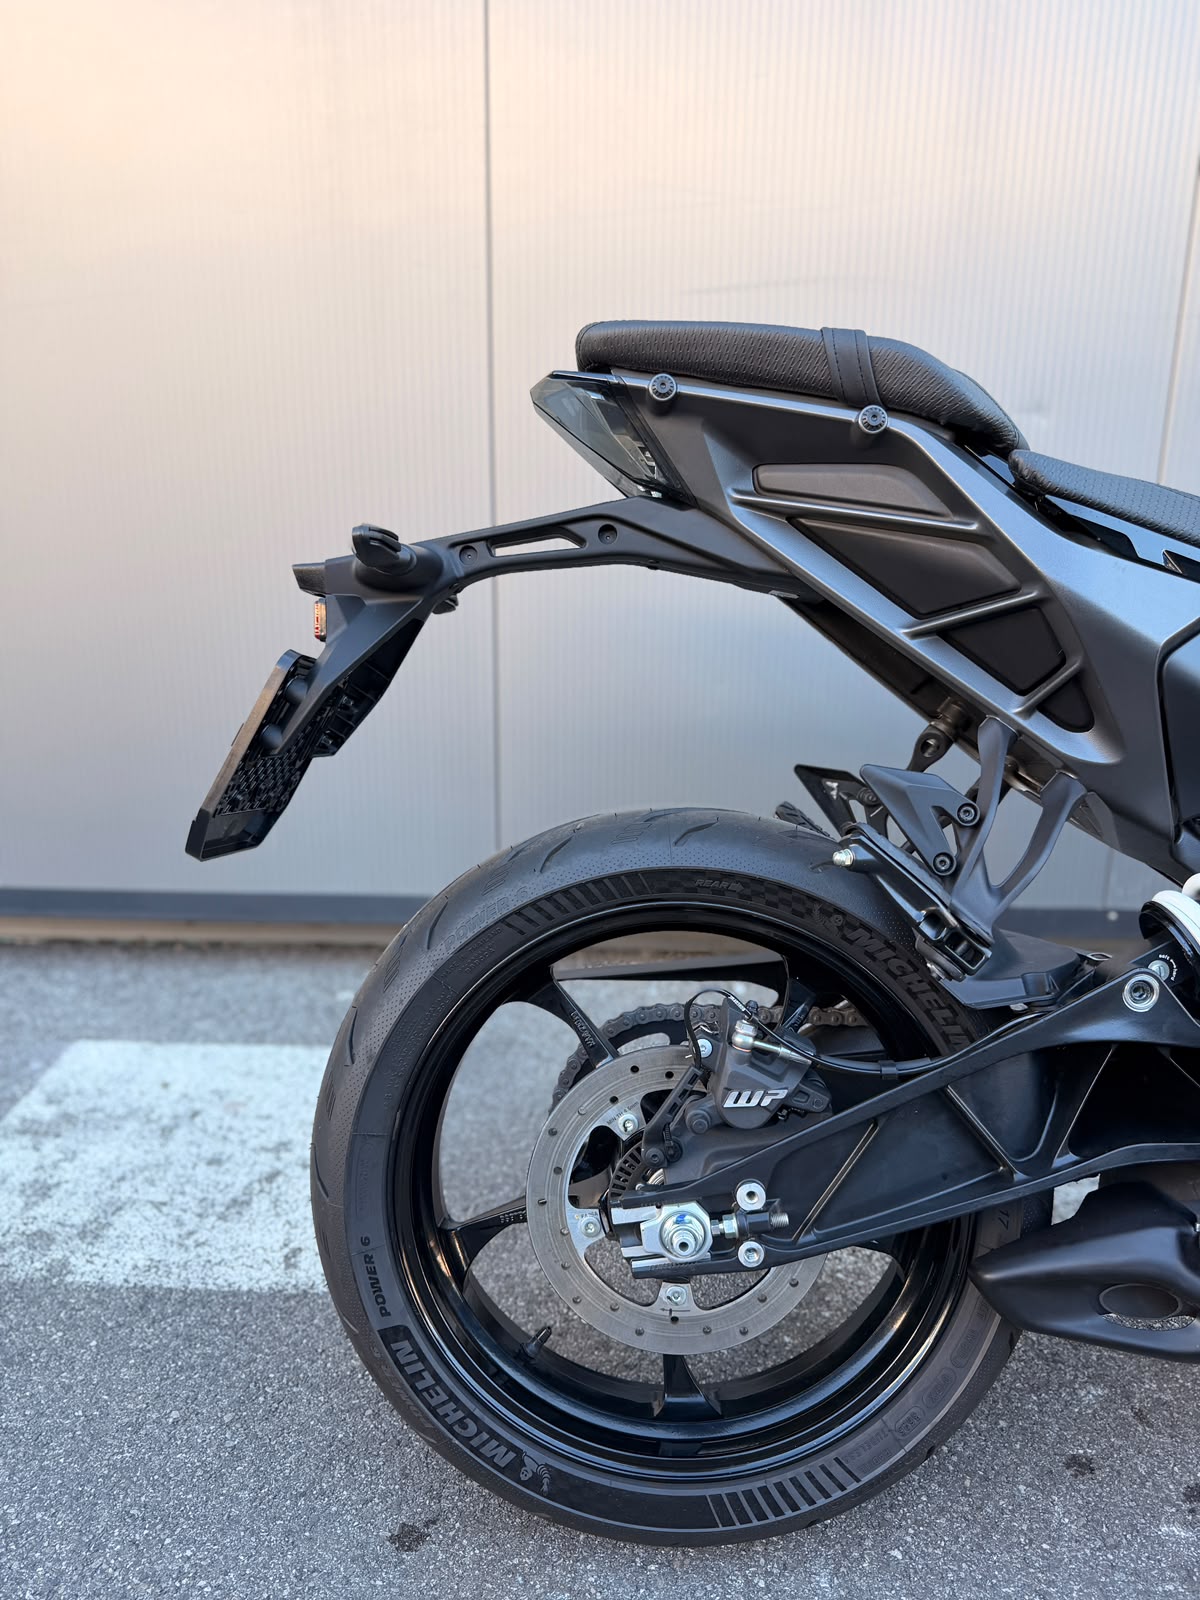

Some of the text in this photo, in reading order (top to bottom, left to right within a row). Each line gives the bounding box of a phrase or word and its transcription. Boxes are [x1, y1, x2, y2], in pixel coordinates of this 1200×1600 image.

[695, 879, 728, 889] REAR
[442, 895, 509, 951] POWER
[723, 1089, 788, 1108] WP
[359, 1235, 371, 1247] 6
[361, 1254, 392, 1318] POWER
[388, 1338, 517, 1468] MICHELIN
